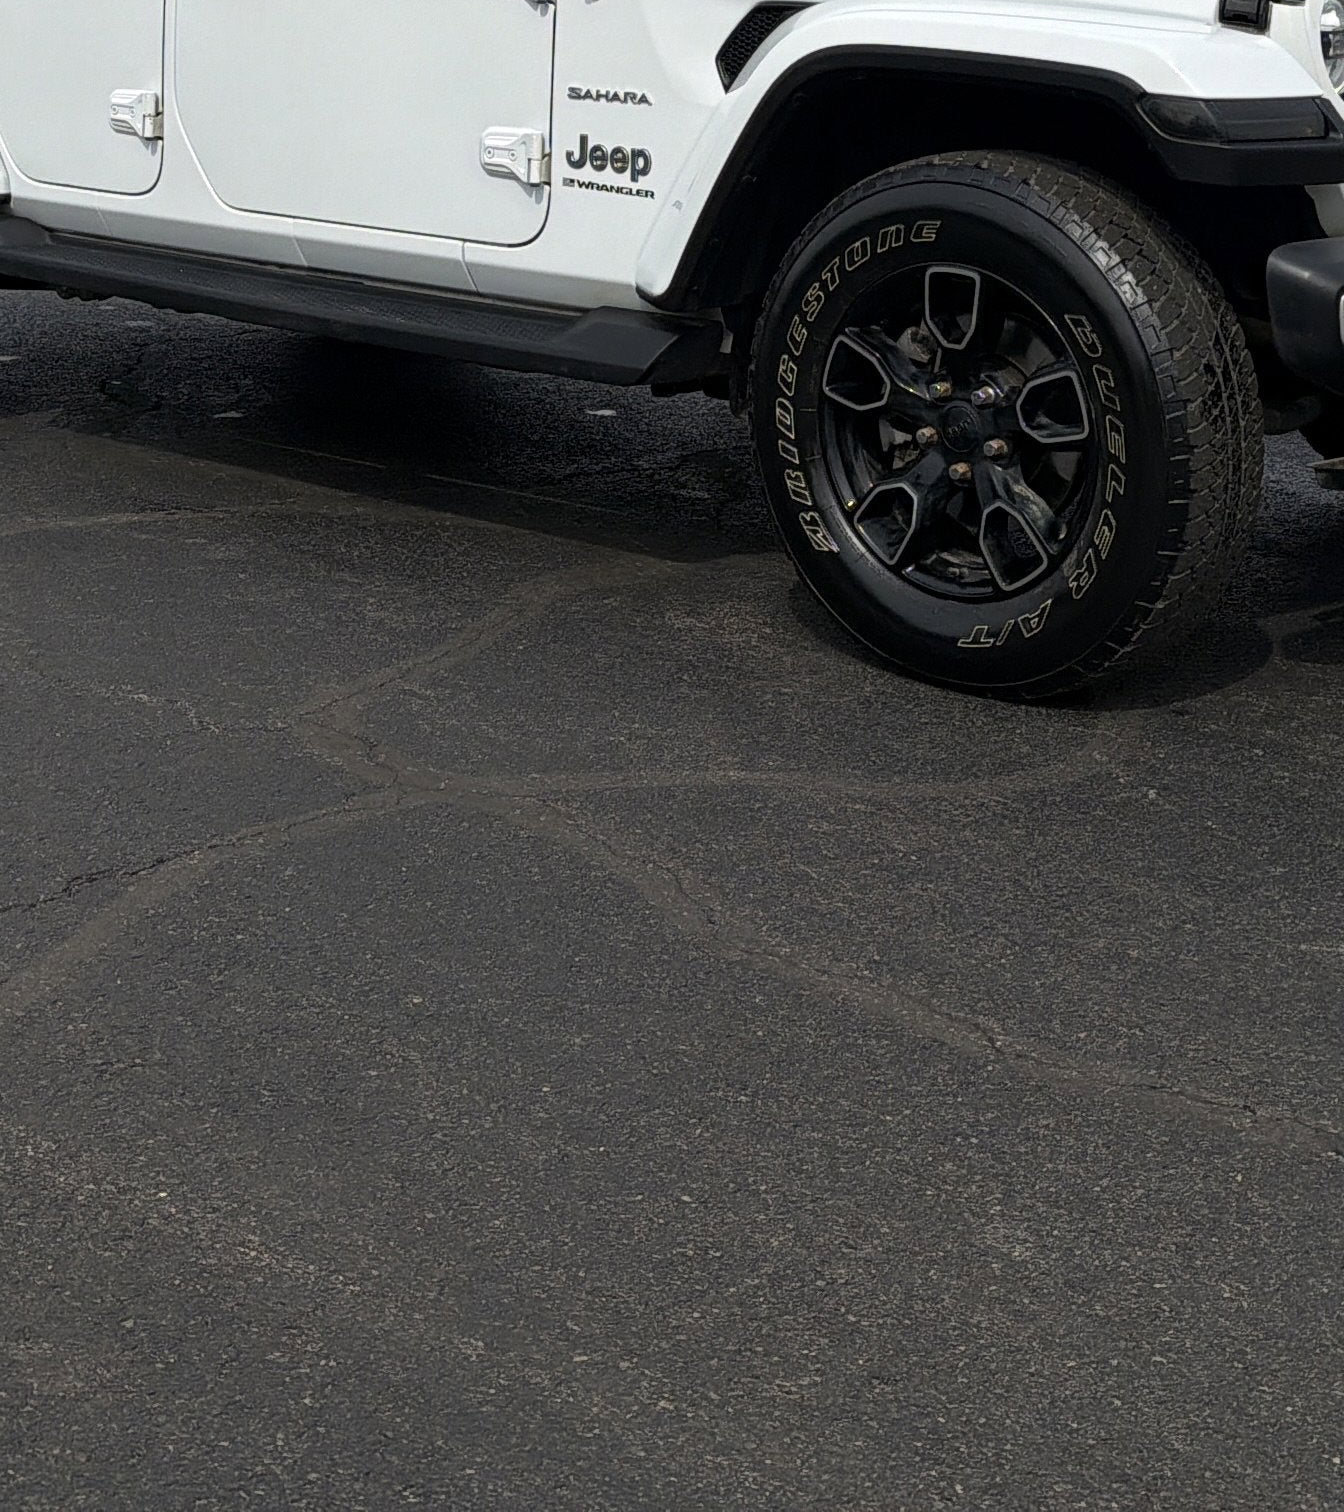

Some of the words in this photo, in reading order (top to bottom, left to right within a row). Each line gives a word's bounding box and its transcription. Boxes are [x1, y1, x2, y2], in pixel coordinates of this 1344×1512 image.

[567, 86, 653, 107] SAHARA
[565, 133, 652, 183] Jeep
[576, 178, 655, 200] WRANGLER
[775, 220, 942, 553] BRIDGESTONE
[1064, 313, 1126, 600] DUELER
[957, 598, 1053, 648] A/T
